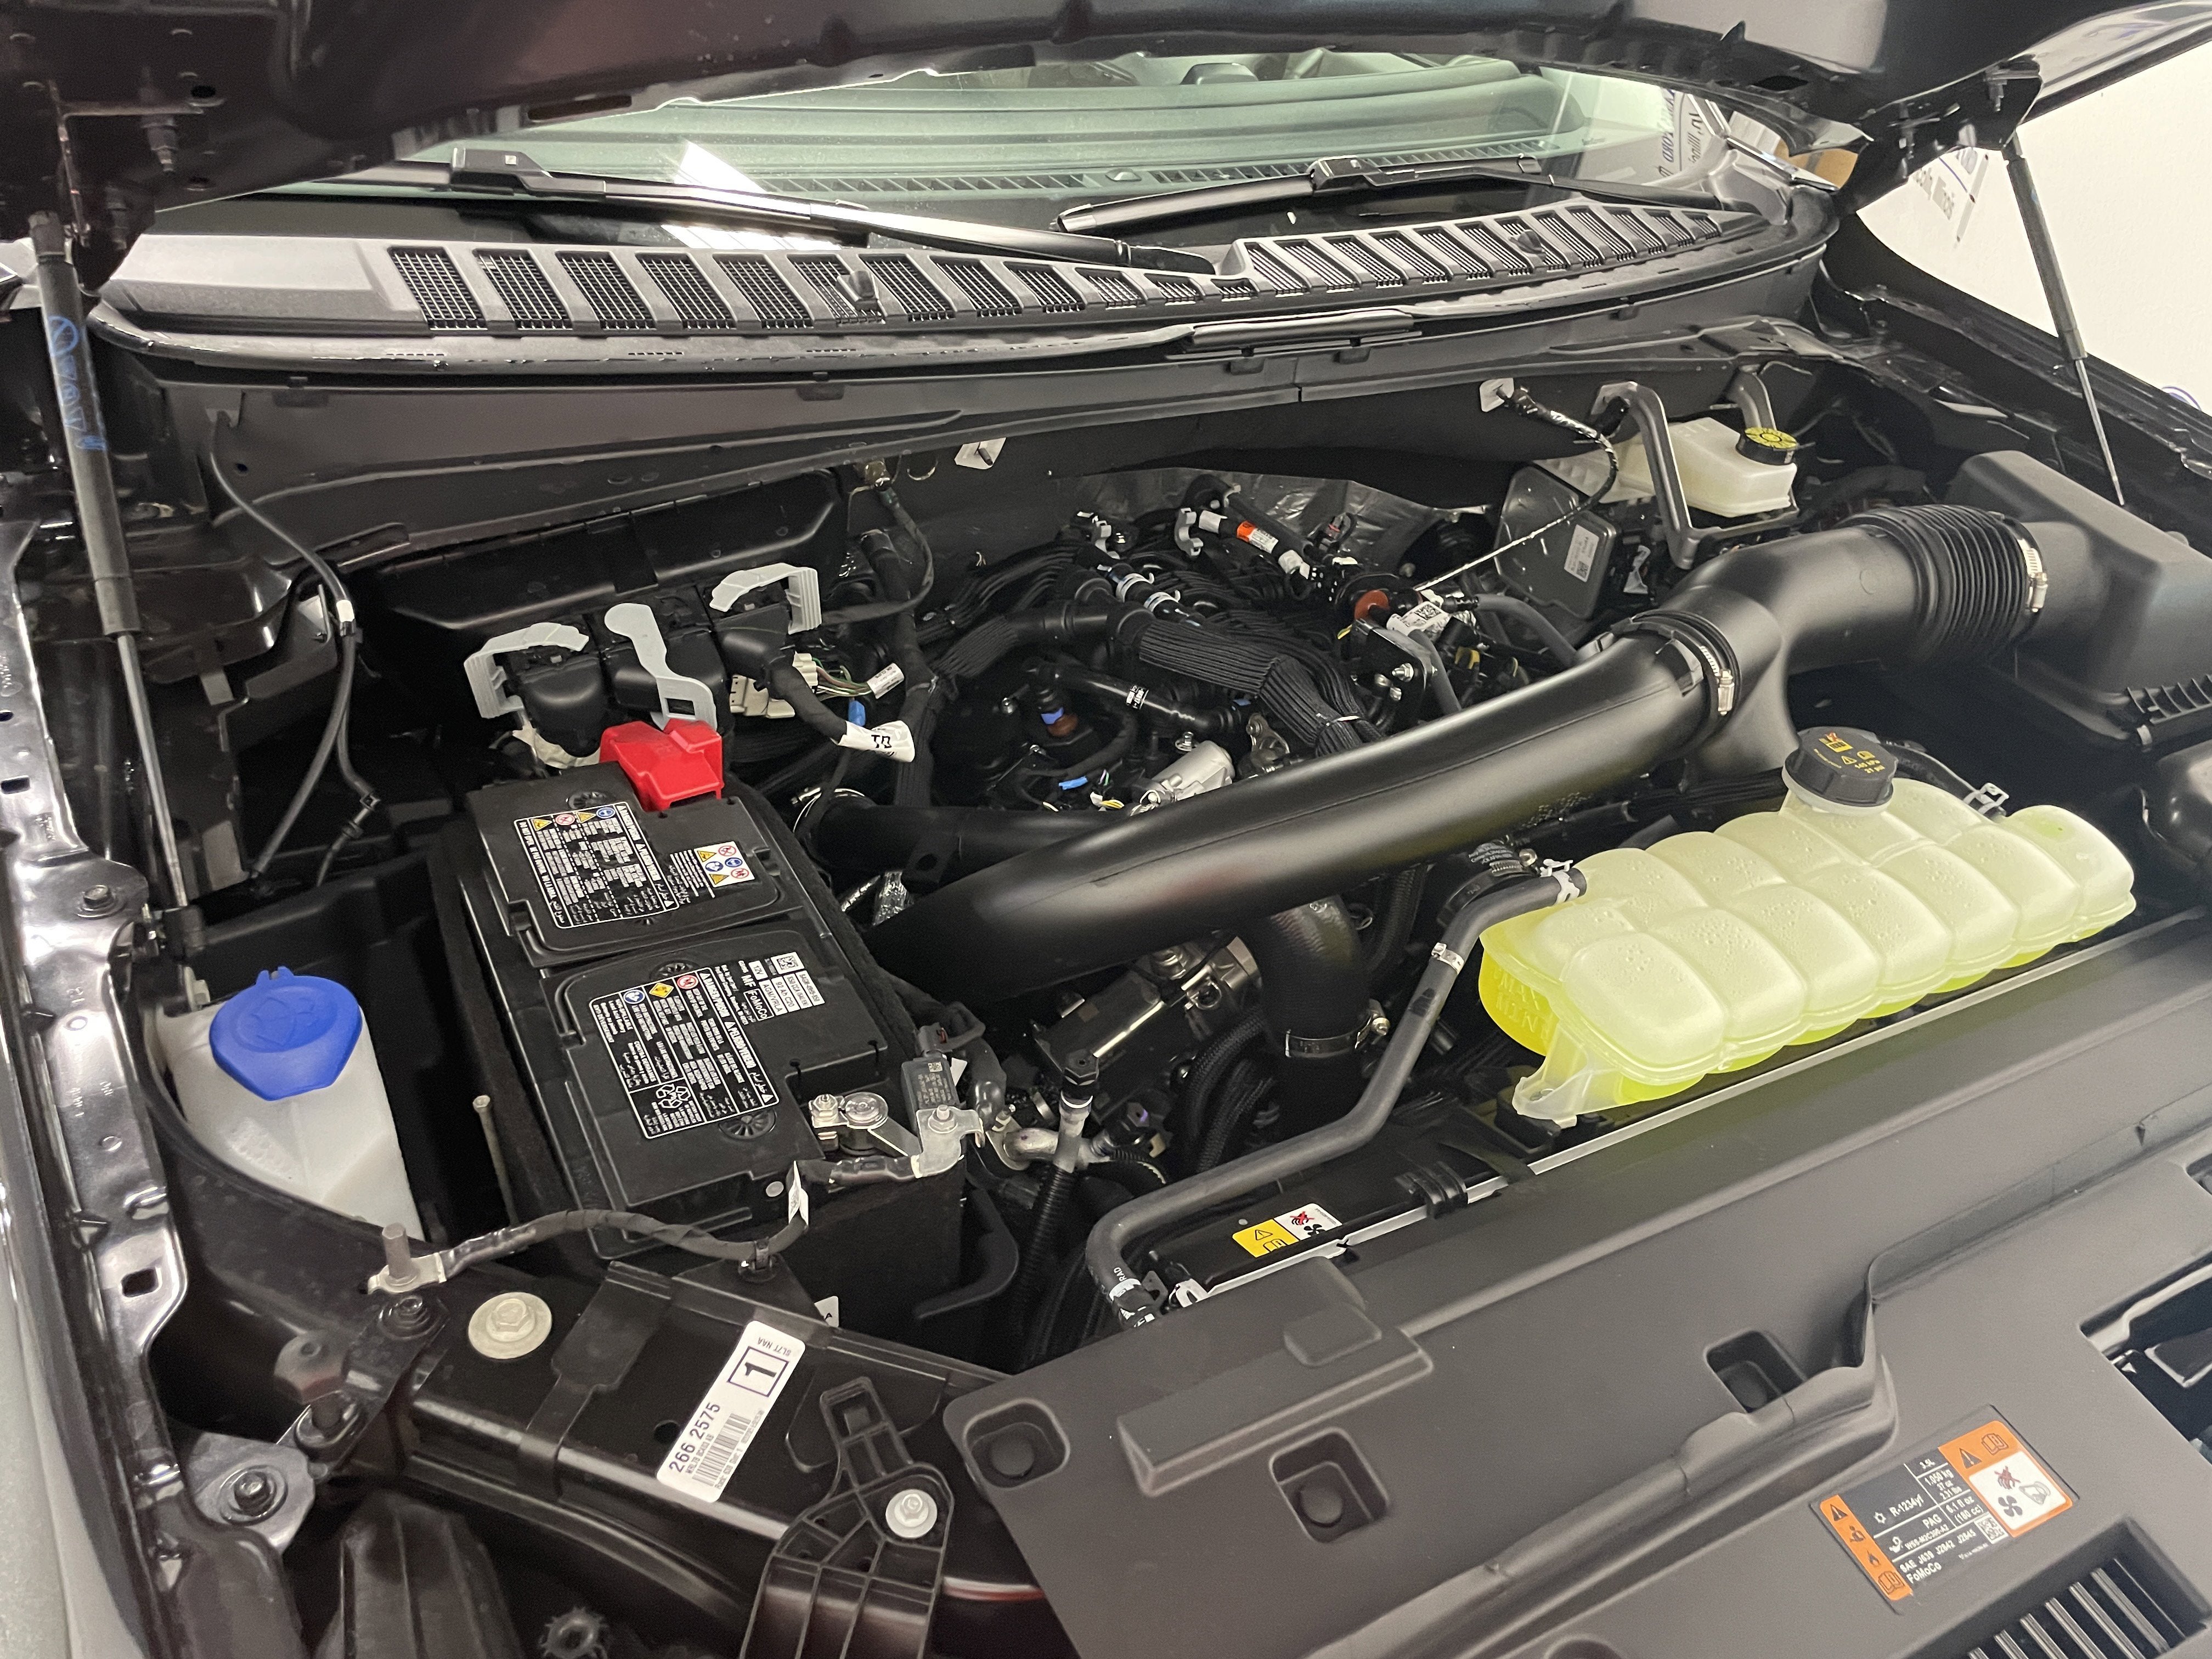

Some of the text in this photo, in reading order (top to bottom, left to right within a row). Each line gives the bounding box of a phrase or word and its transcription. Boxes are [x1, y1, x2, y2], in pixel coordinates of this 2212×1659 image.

[753, 965, 764, 974] 12V
[741, 974, 756, 987] MF
[748, 990, 769, 1019] FoMoCo
[763, 984, 782, 1012] AGM/VRLA
[785, 996, 794, 1007] C20
[1114, 1266, 1128, 1282] RAD
[744, 1362, 776, 1377] 1
[669, 1442, 695, 1472] 266
[689, 1402, 720, 1439] 2575
[1924, 1469, 1954, 1486] 1.050 kg
[1889, 1494, 1923, 1516] R-1234yf
[1945, 1502, 1959, 1513] 6.1
[1963, 1496, 1974, 1504] oz
[1922, 1514, 1942, 1528] PAG
[1954, 1504, 1983, 1523] (180 cc)
[1899, 1559, 1917, 1572] SAE
[1906, 1562, 1941, 1583] FoMoCo
